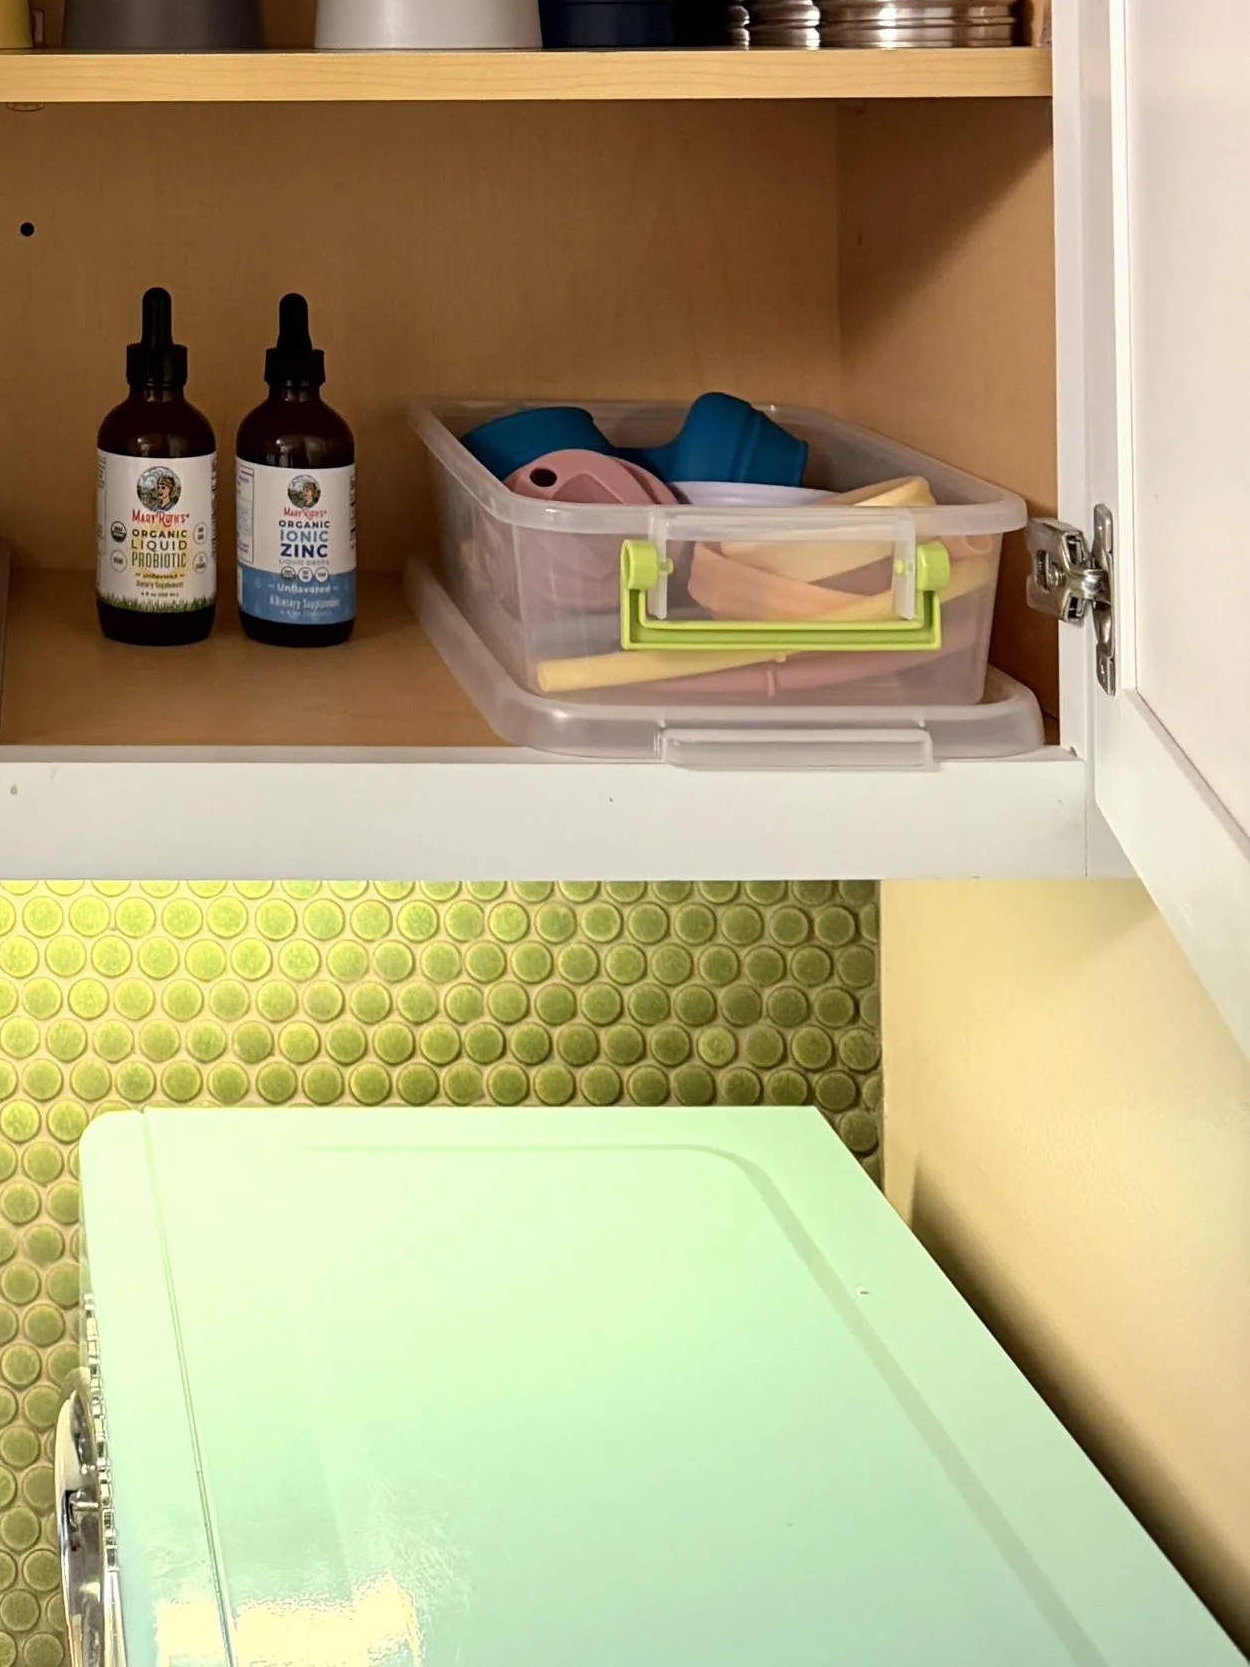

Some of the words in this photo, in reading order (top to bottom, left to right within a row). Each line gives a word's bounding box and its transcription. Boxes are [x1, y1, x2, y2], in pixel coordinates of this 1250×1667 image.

[278, 519, 330, 529] ORGANIC
[132, 528, 187, 539] ORGANIC
[280, 529, 329, 543] IONIC
[131, 540, 187, 552] LIQUID
[280, 543, 328, 558] ZINC
[131, 552, 187, 569] PROBIOTIC
[277, 582, 331, 593] Unflavored
